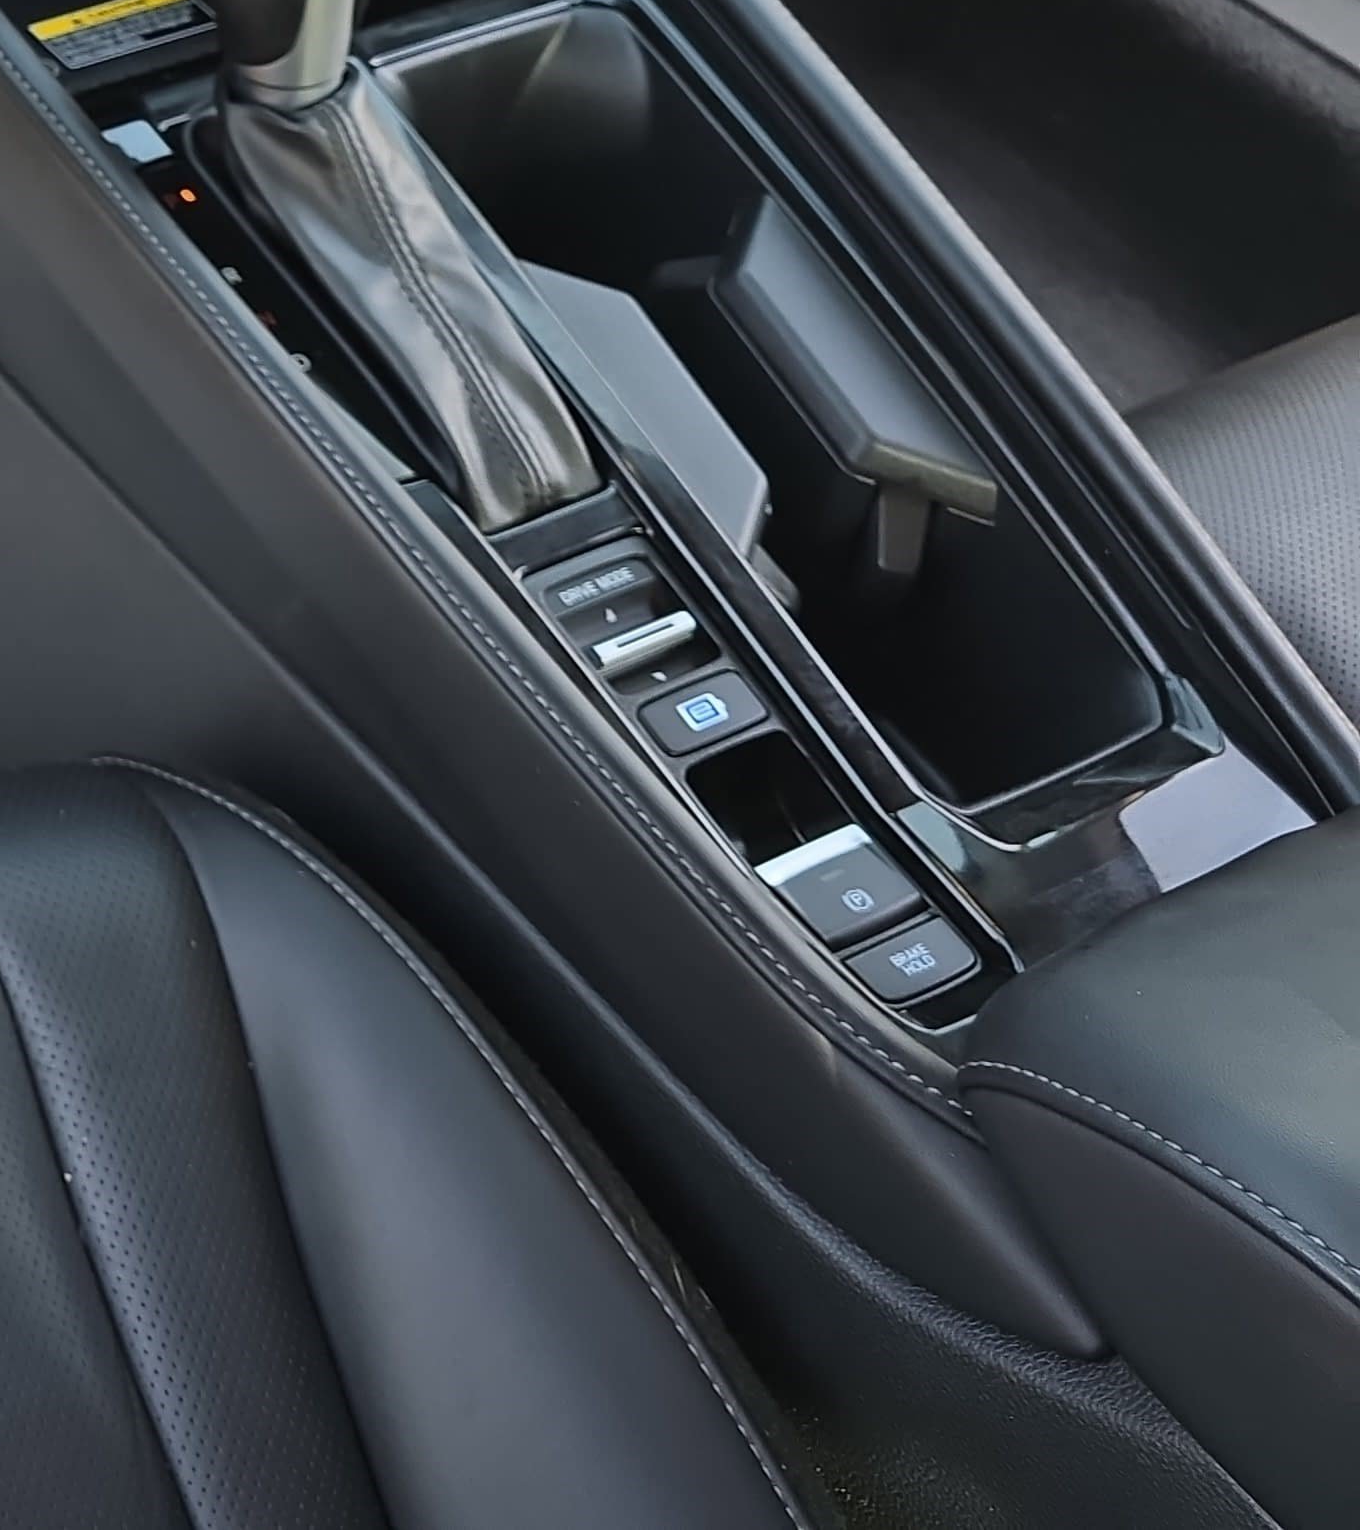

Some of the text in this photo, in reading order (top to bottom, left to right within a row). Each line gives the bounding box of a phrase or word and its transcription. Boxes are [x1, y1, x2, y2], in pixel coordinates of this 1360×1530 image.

[558, 566, 635, 606] DRIVE MODE
[889, 942, 929, 968] BRAKE
[901, 954, 936, 977] HOLD
